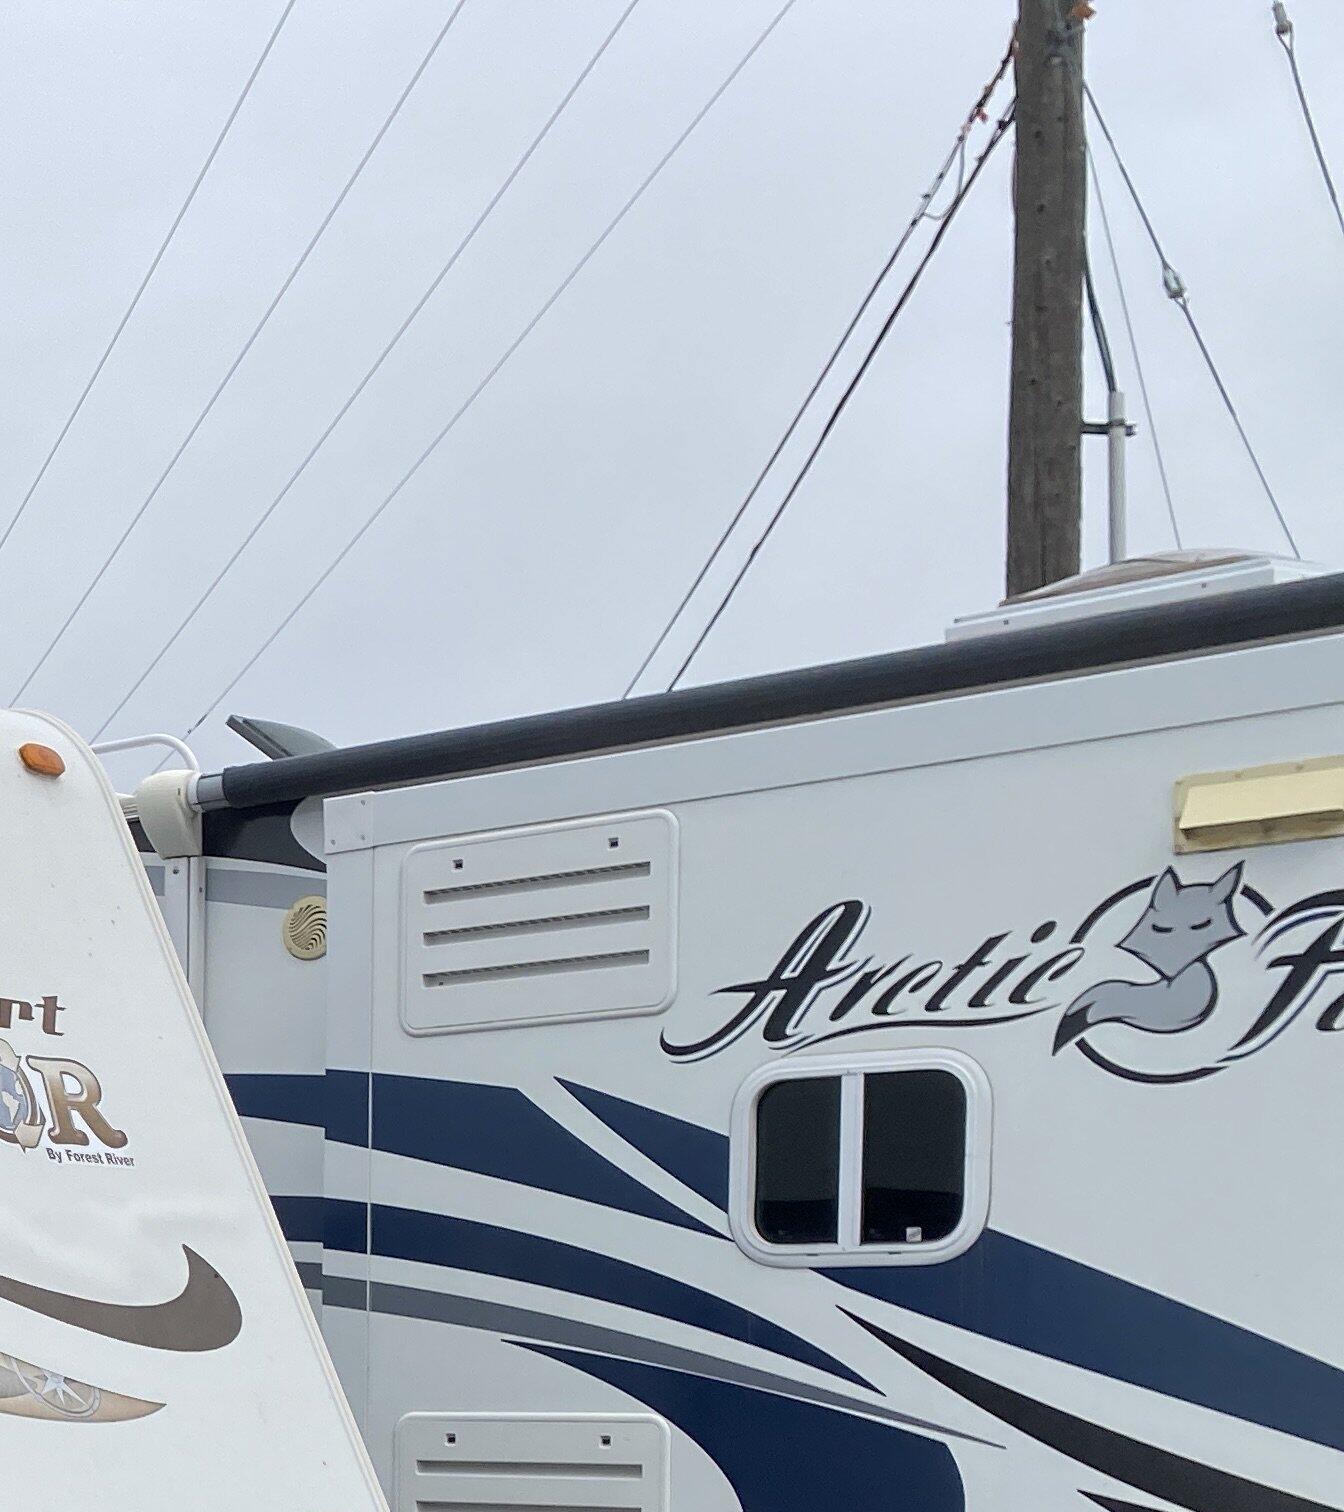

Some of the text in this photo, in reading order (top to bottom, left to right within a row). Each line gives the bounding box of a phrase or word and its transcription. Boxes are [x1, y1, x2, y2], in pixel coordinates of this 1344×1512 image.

[659, 899, 1086, 1064] Arctic
[45, 1147, 135, 1167] By Forest River
